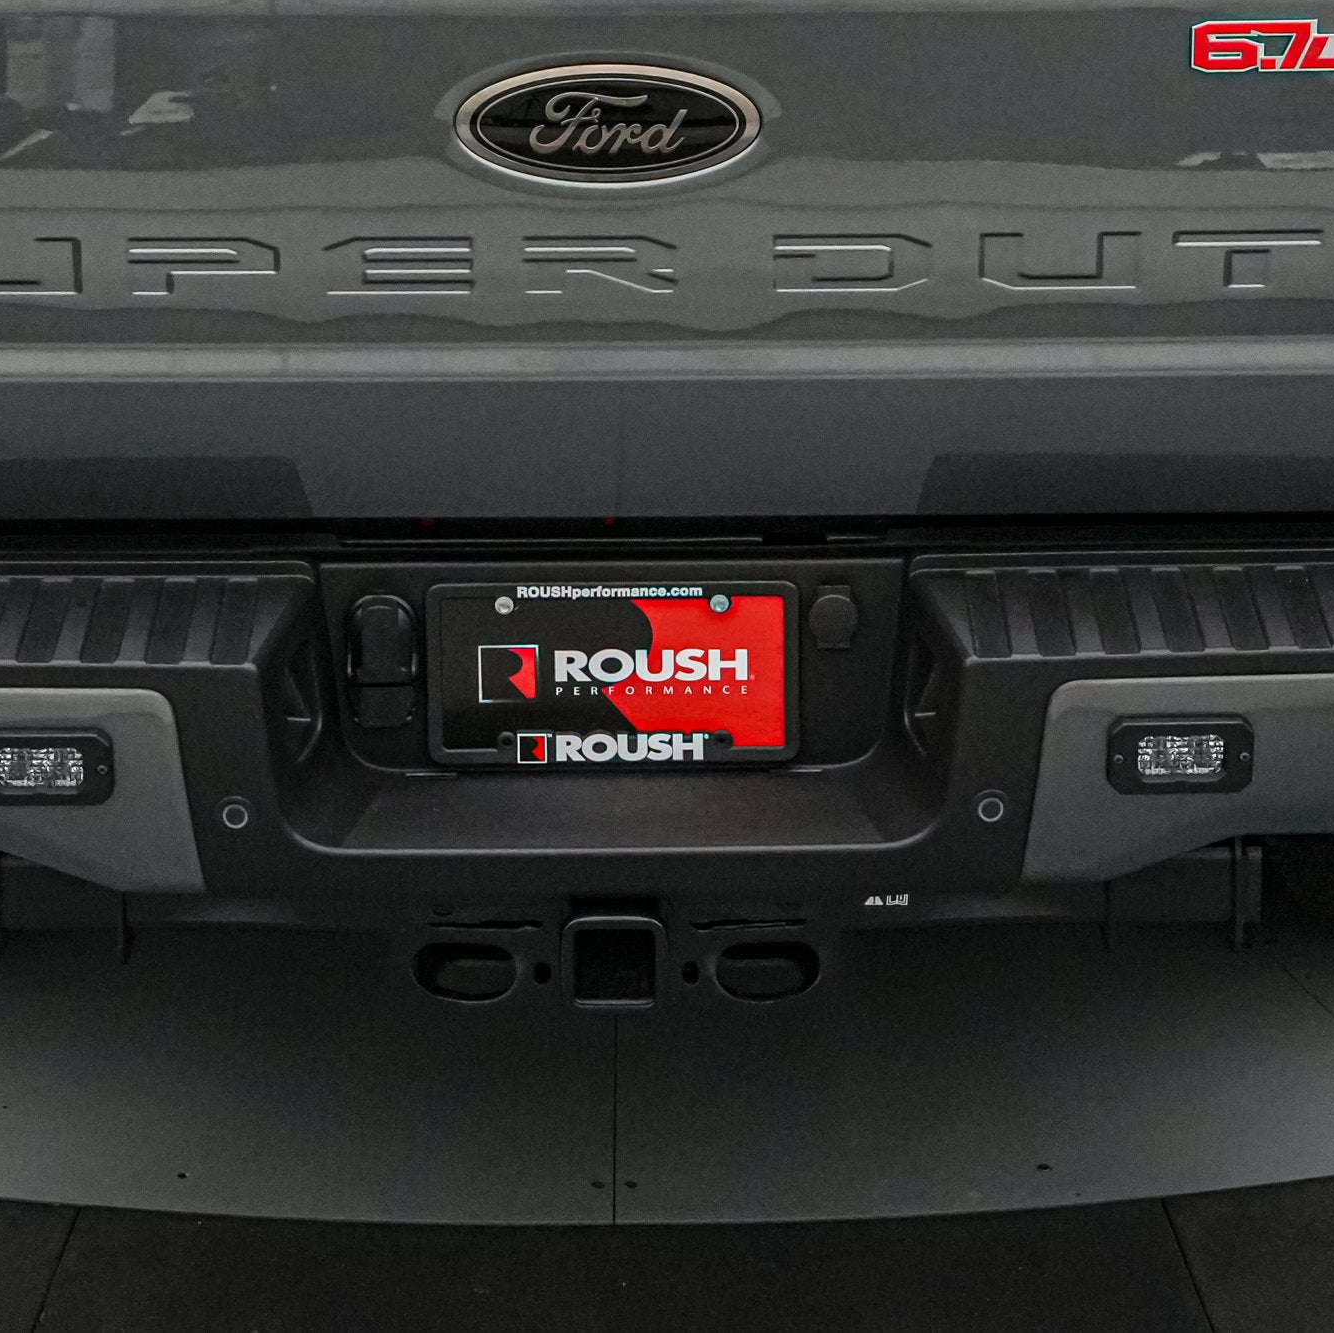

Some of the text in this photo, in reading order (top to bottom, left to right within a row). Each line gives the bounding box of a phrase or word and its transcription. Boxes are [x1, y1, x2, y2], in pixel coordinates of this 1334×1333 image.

[528, 91, 688, 155] Ford
[517, 586, 702, 599] ROUSHperformance.com
[554, 649, 748, 683] ROUSH
[556, 685, 748, 696] PERFORMANCE
[555, 733, 704, 762] ROUSH
